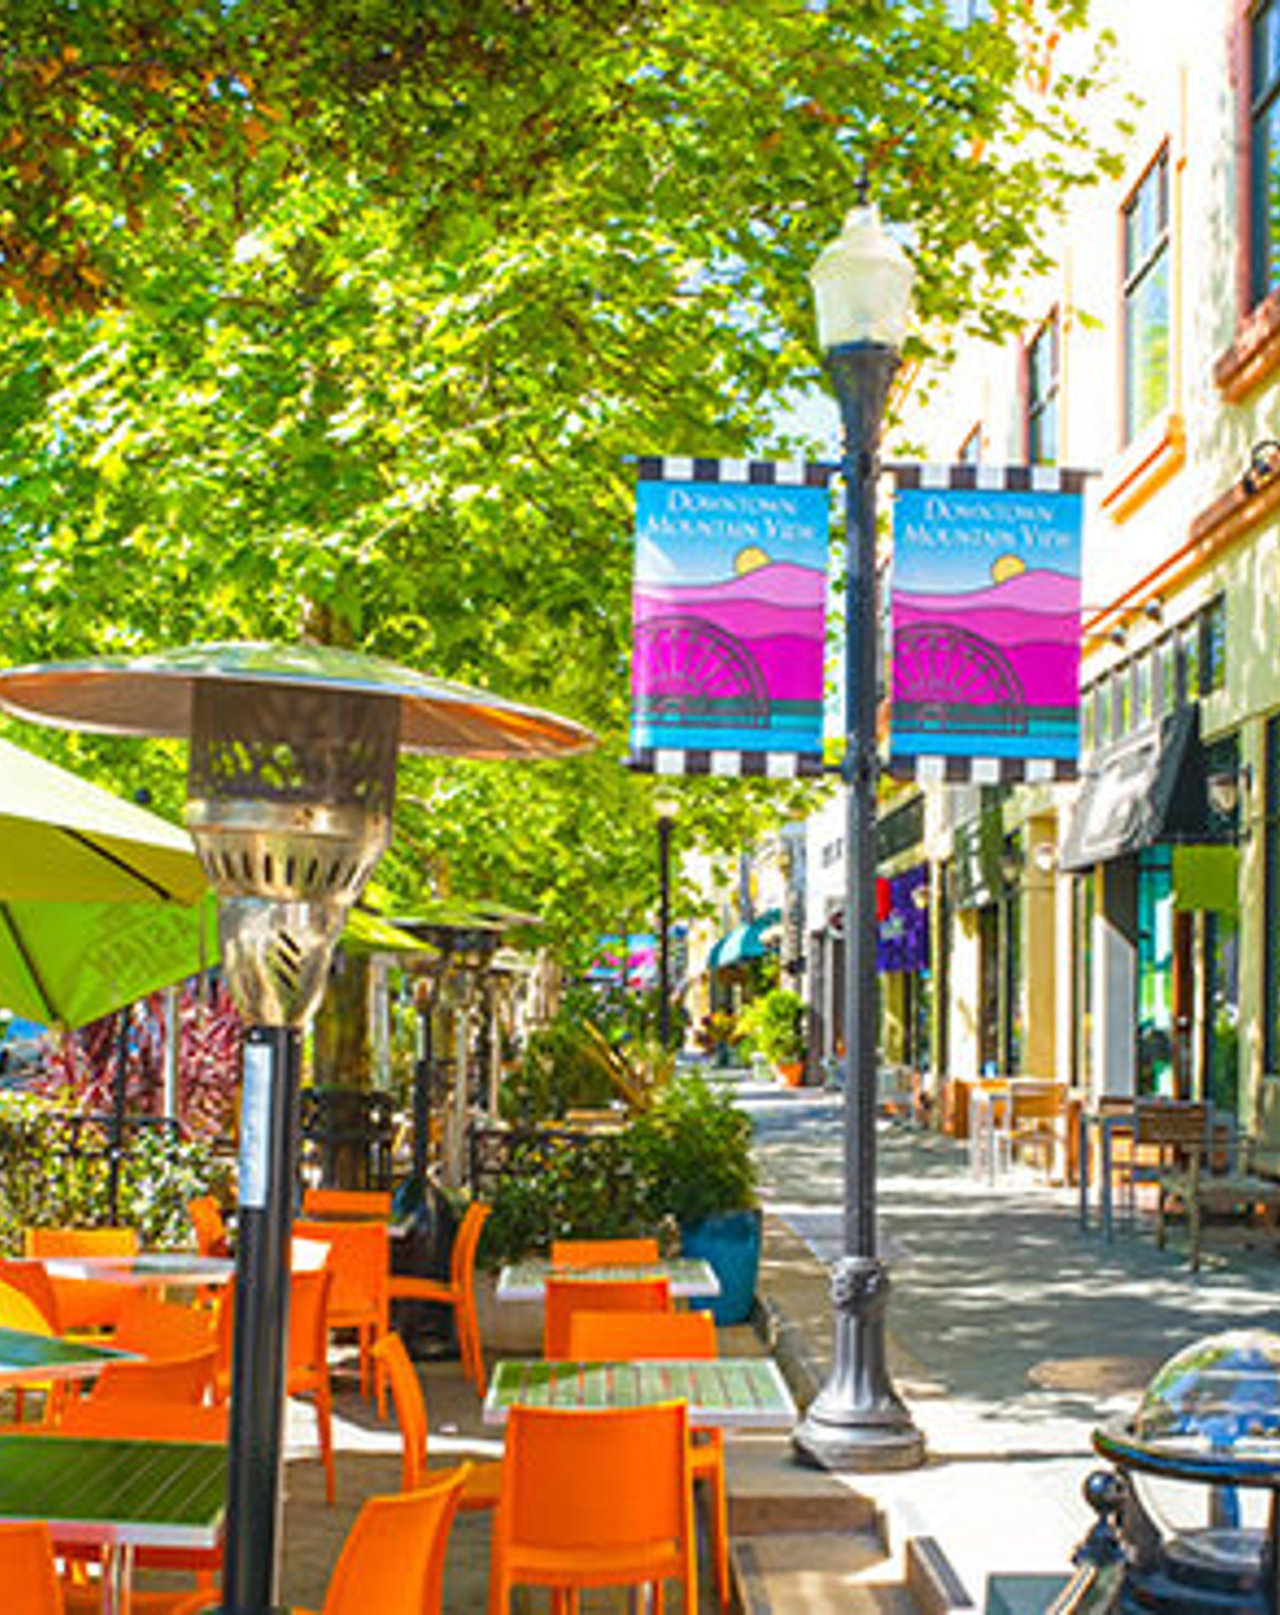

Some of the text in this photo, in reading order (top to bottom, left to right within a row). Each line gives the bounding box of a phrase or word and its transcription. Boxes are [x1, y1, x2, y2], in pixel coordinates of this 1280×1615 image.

[668, 489, 797, 515] DOWNTOWN
[924, 496, 1053, 523] DOWNTOWN
[646, 514, 759, 540] MOUNTAIN
[903, 523, 1017, 549] MOUNTAIN
